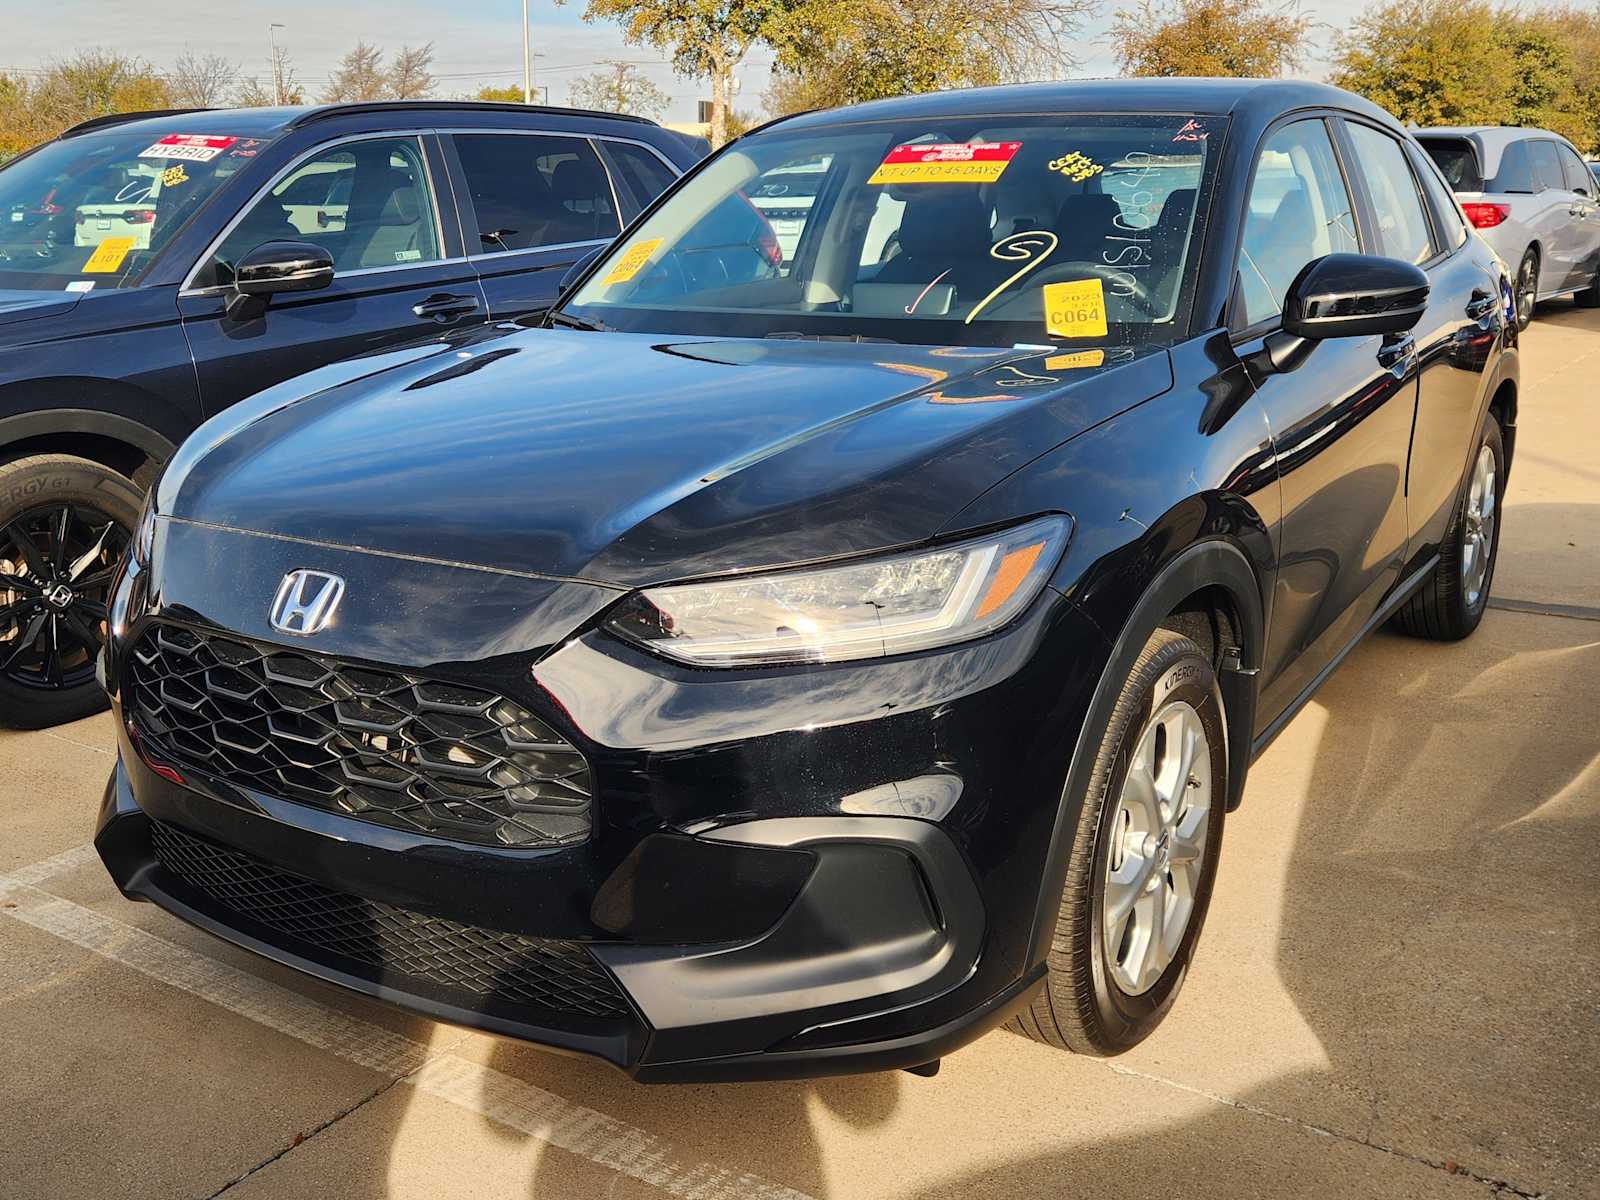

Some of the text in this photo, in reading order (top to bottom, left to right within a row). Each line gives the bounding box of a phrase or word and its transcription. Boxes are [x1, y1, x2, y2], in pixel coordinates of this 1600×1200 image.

[143, 145, 216, 160] HYBRID
[900, 167, 921, 176] UP
[924, 167, 941, 176] TO
[944, 166, 960, 176] 45
[962, 165, 1001, 176] DAYS
[1051, 308, 1099, 325] C064
